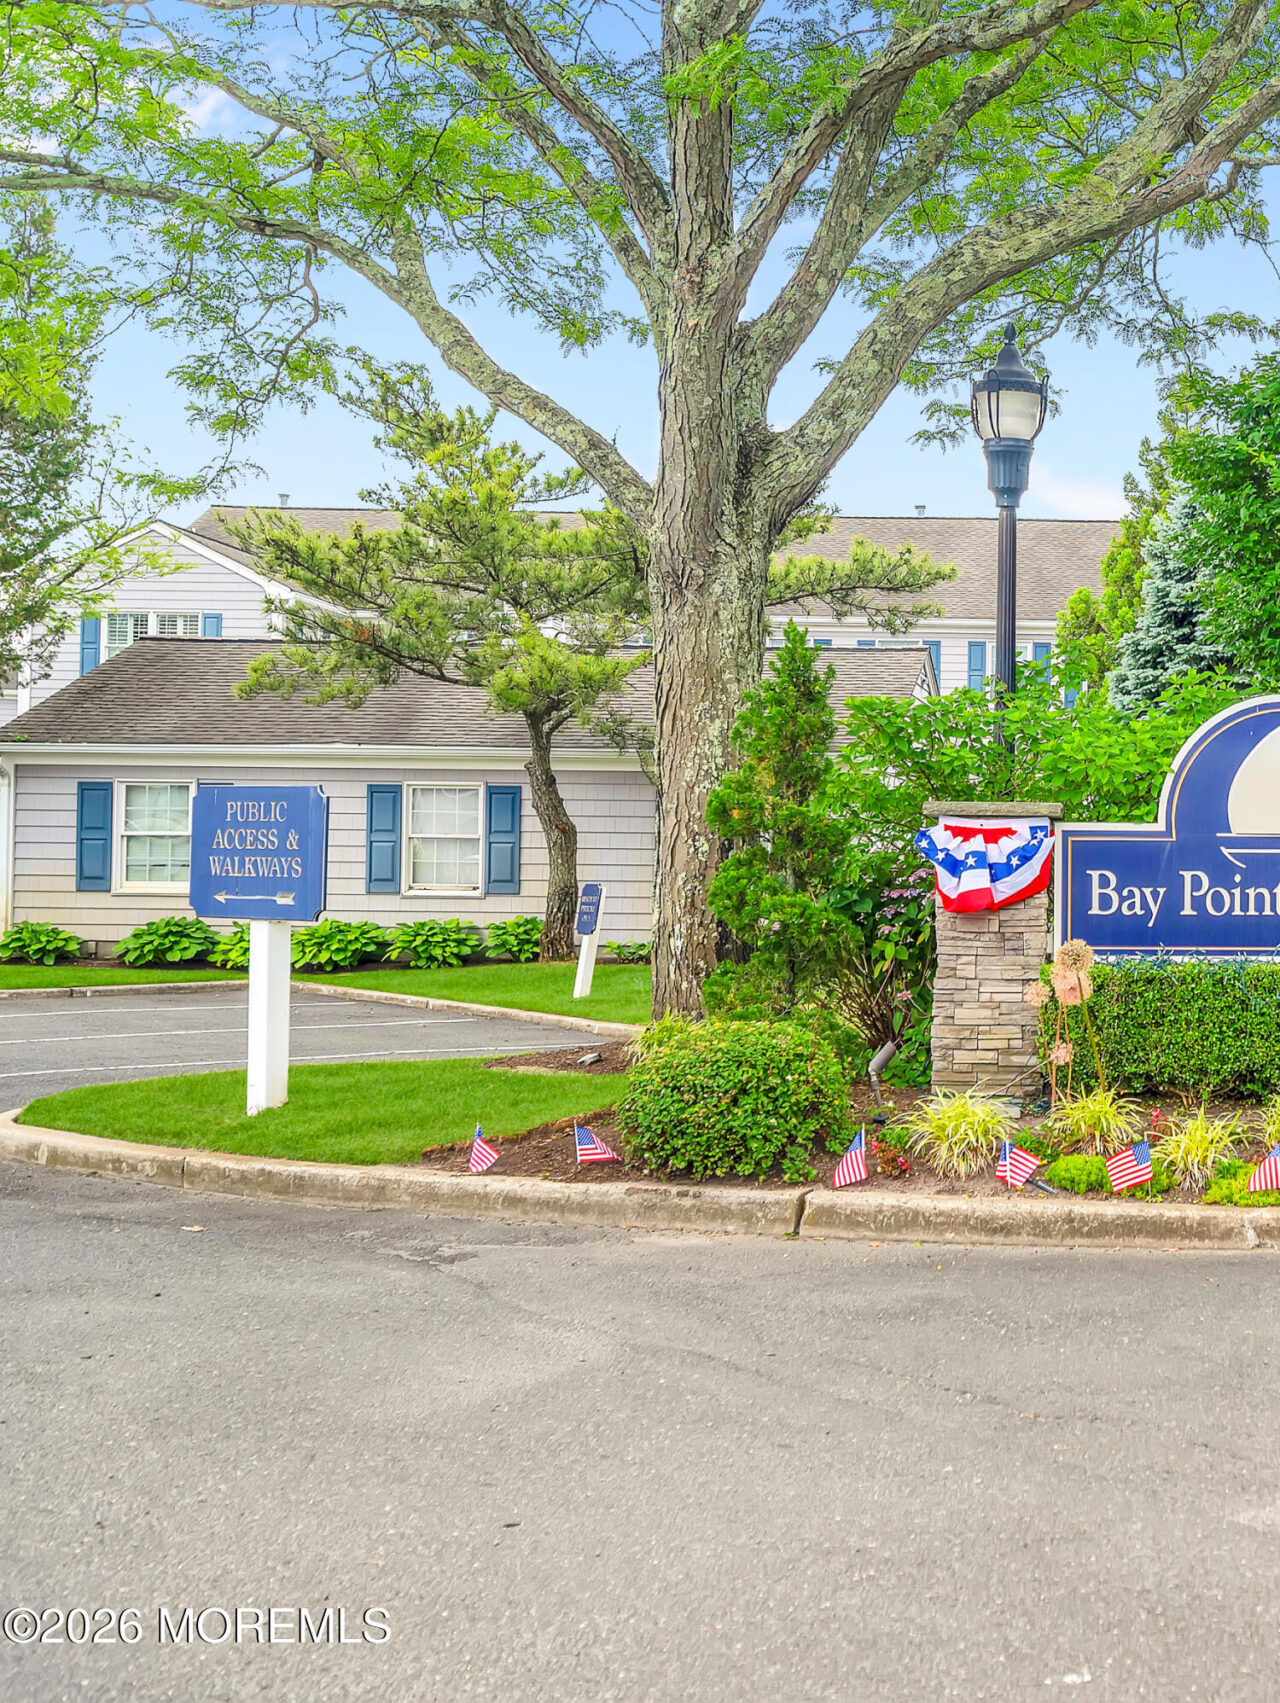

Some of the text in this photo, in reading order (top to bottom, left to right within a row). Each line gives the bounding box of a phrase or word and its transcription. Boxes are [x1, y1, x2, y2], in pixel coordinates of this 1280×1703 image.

[225, 801, 288, 822] PUBLIC
[212, 828, 300, 850] ACCESS &
[208, 855, 303, 878] WALKWAYS
[1086, 870, 1166, 927] Bay
